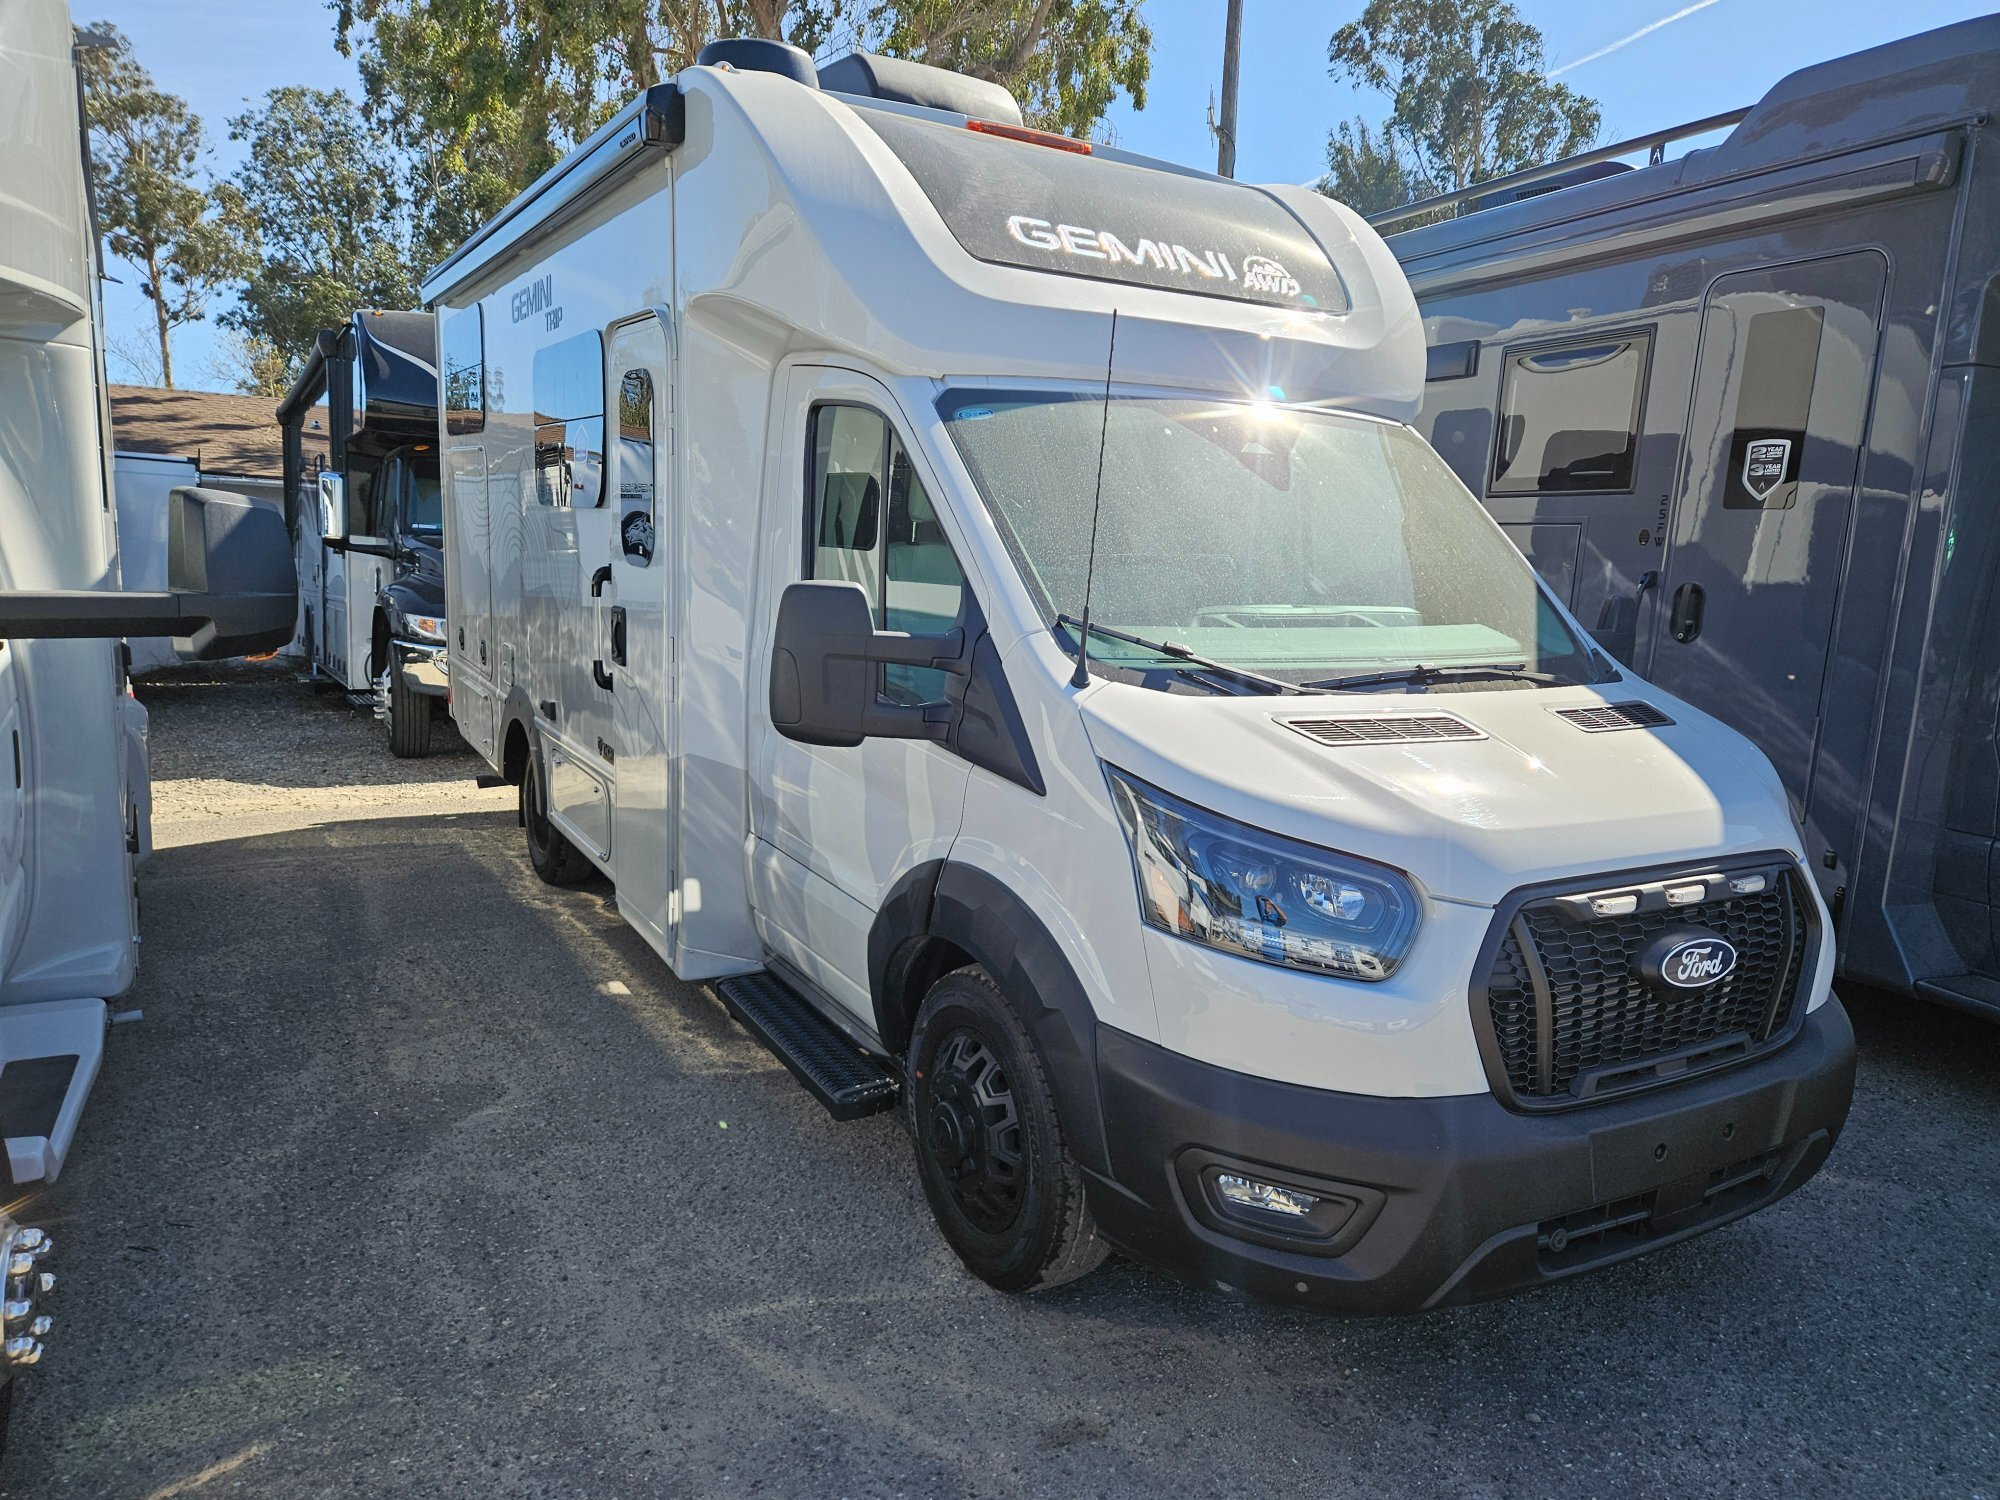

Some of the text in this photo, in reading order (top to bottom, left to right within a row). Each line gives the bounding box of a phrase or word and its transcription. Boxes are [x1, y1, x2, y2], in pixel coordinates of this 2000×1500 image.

[1007, 215, 1301, 297] GEMINI AWD
[511, 273, 552, 324] GEMINI
[544, 306, 563, 333] TRIP
[1751, 446, 1768, 459] 2
[1749, 464, 1765, 476] 3
[1677, 946, 1723, 980] Ford
